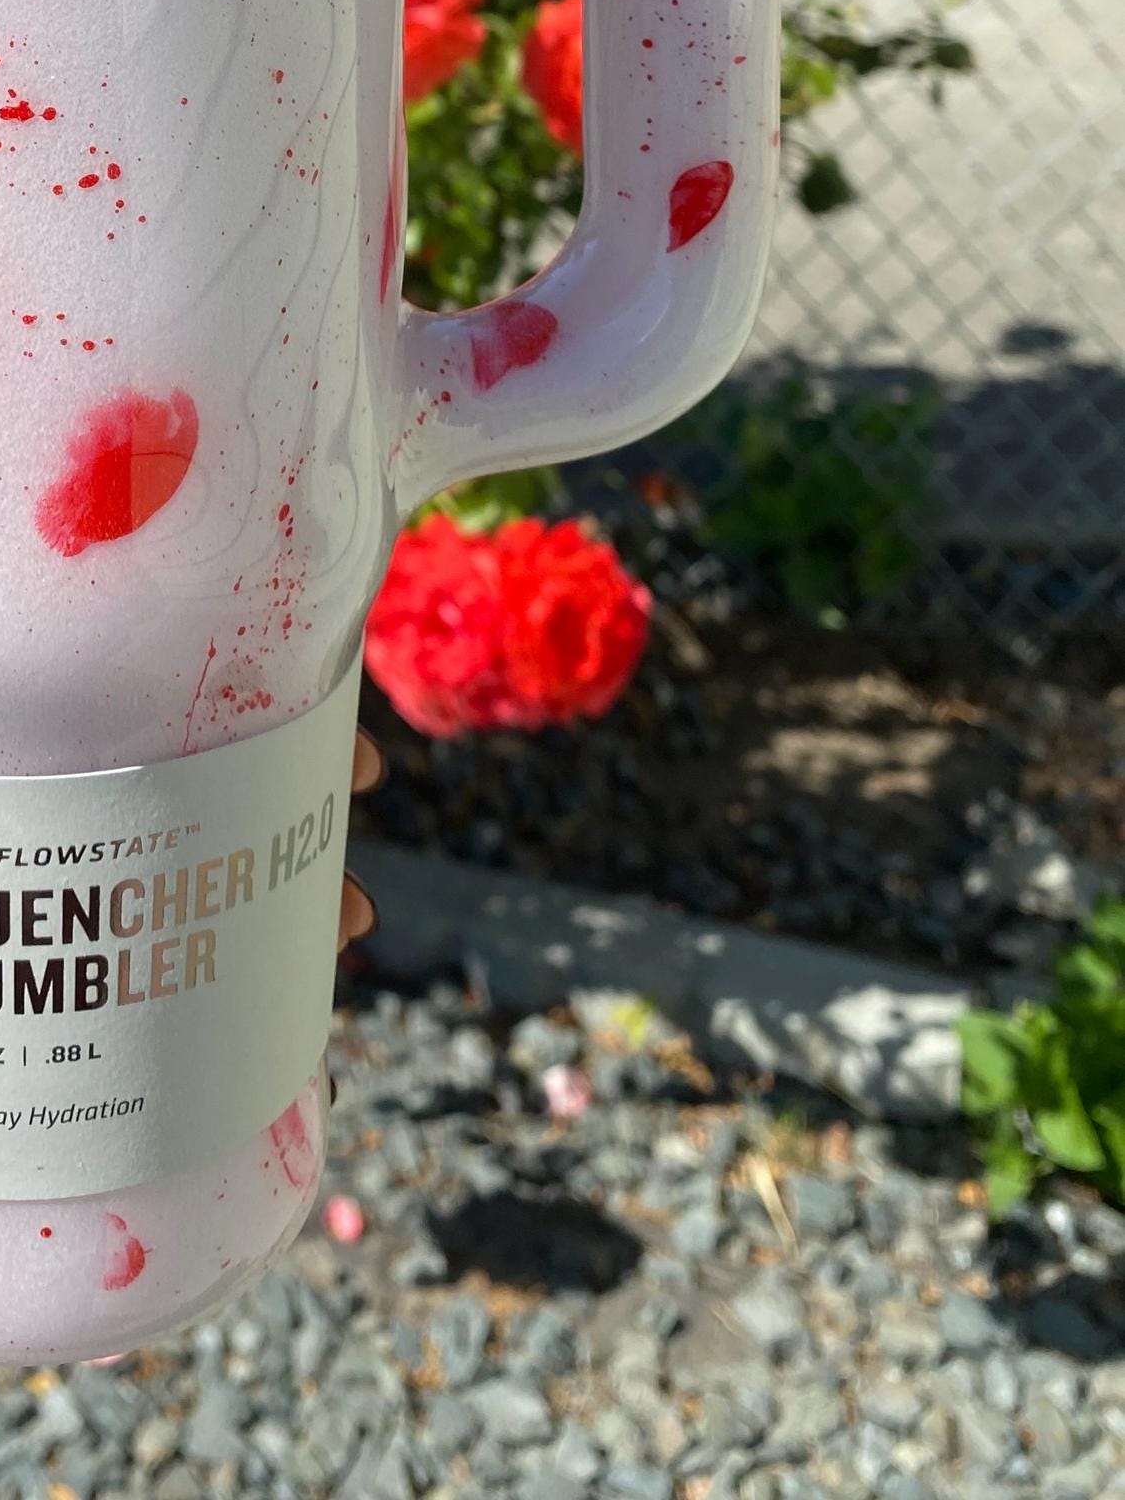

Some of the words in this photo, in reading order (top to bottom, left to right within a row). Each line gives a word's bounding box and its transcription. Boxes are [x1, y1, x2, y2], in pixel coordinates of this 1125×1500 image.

[267, 792, 335, 892] H2.0
[45, 1044, 82, 1065] .88
[88, 1042, 102, 1060] L
[28, 1096, 145, 1130] Hydration
